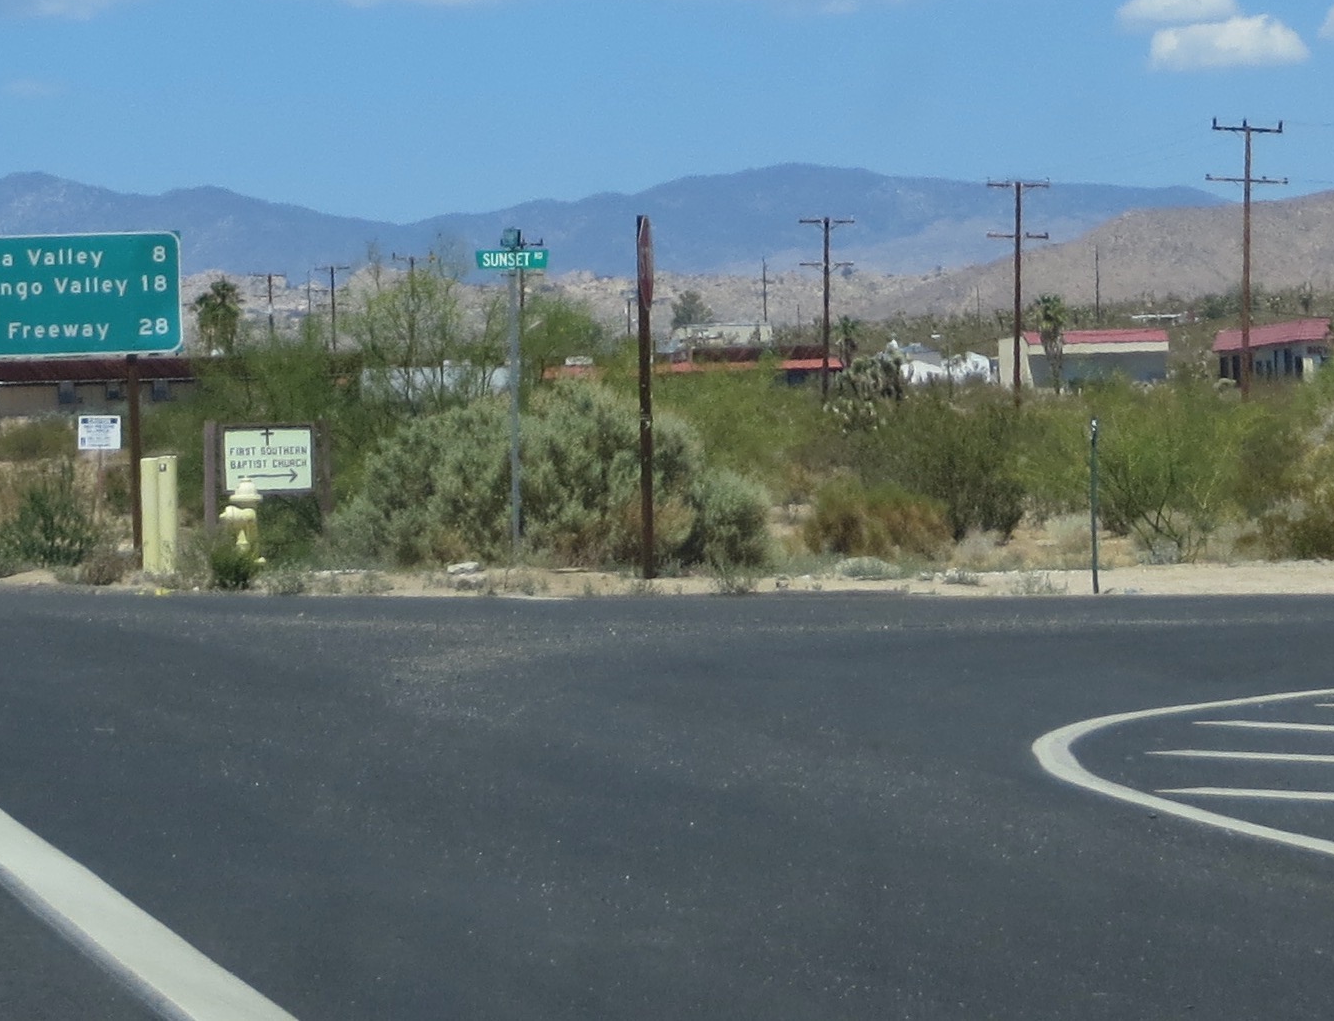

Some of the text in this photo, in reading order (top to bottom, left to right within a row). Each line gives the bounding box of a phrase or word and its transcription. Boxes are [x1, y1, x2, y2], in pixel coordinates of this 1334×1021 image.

[27, 248, 103, 268] Valley
[153, 245, 166, 262] 8
[482, 252, 530, 267] SUNSET
[54, 276, 128, 297] Valley
[141, 275, 167, 292] 18
[8, 318, 169, 341] Freeway 28
[230, 446, 307, 456] FIRST SOUTHERN
[230, 459, 307, 469] BAPTIST CHURCH
